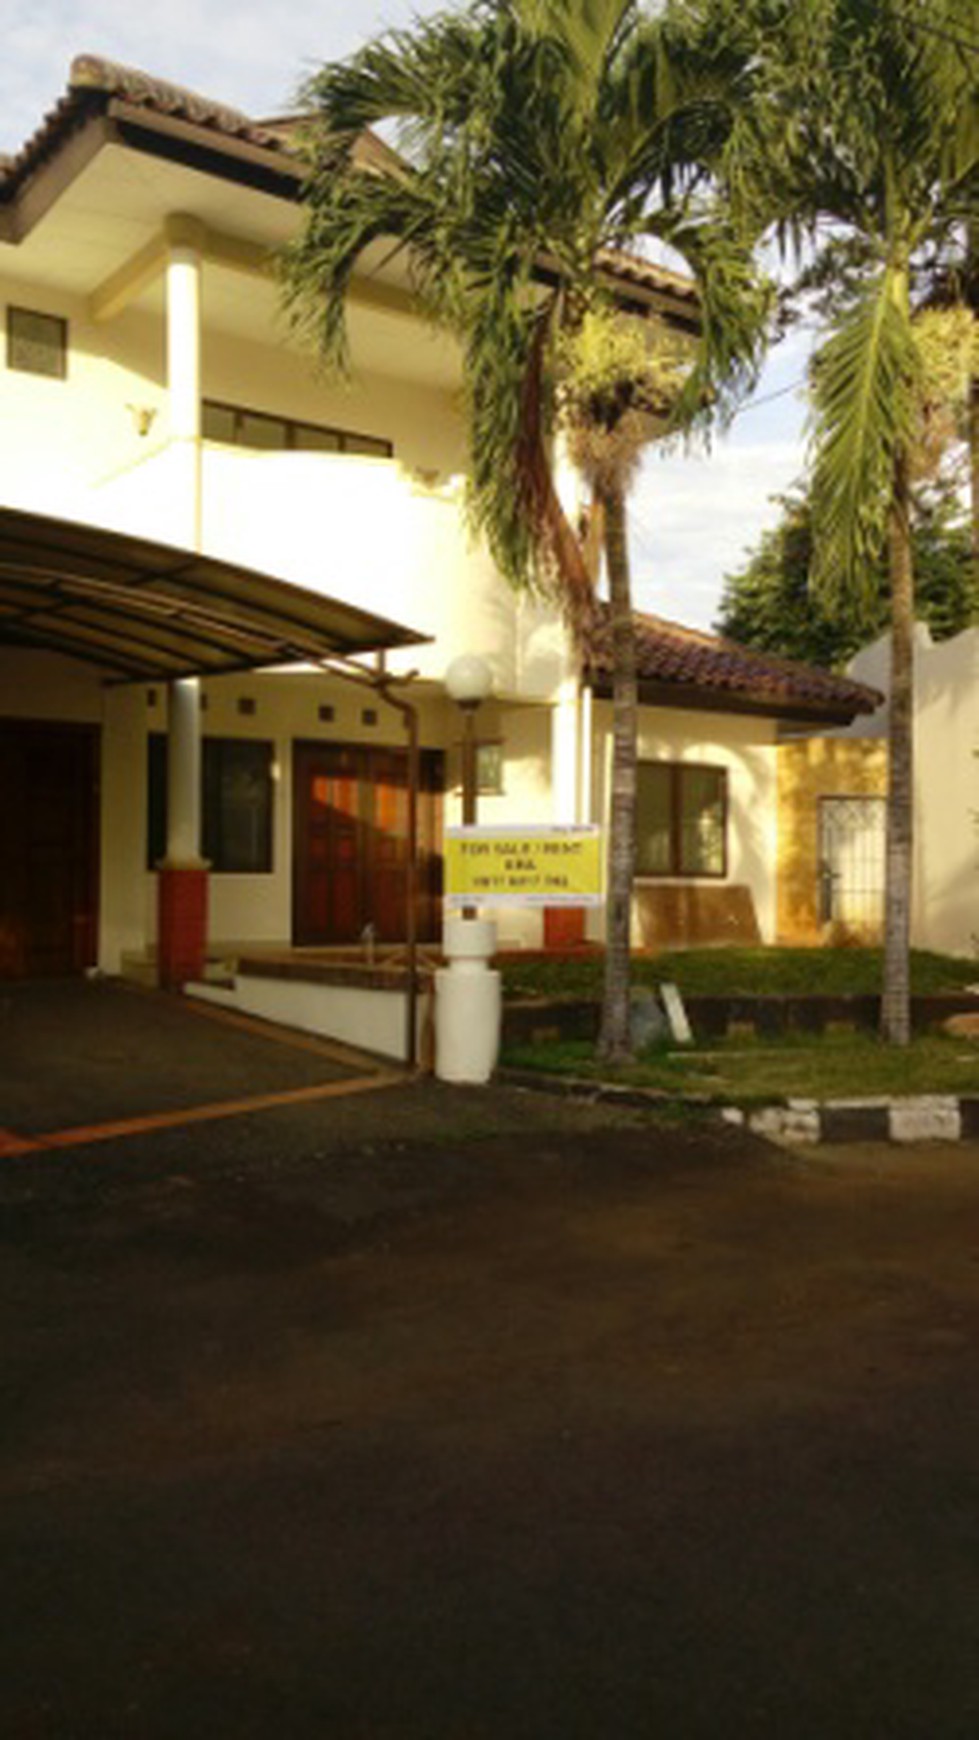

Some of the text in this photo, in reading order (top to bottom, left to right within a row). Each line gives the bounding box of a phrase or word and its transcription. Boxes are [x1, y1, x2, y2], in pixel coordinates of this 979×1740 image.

[460, 842, 490, 855] FOR
[494, 842, 530, 855] SALE
[543, 842, 583, 855] RENT
